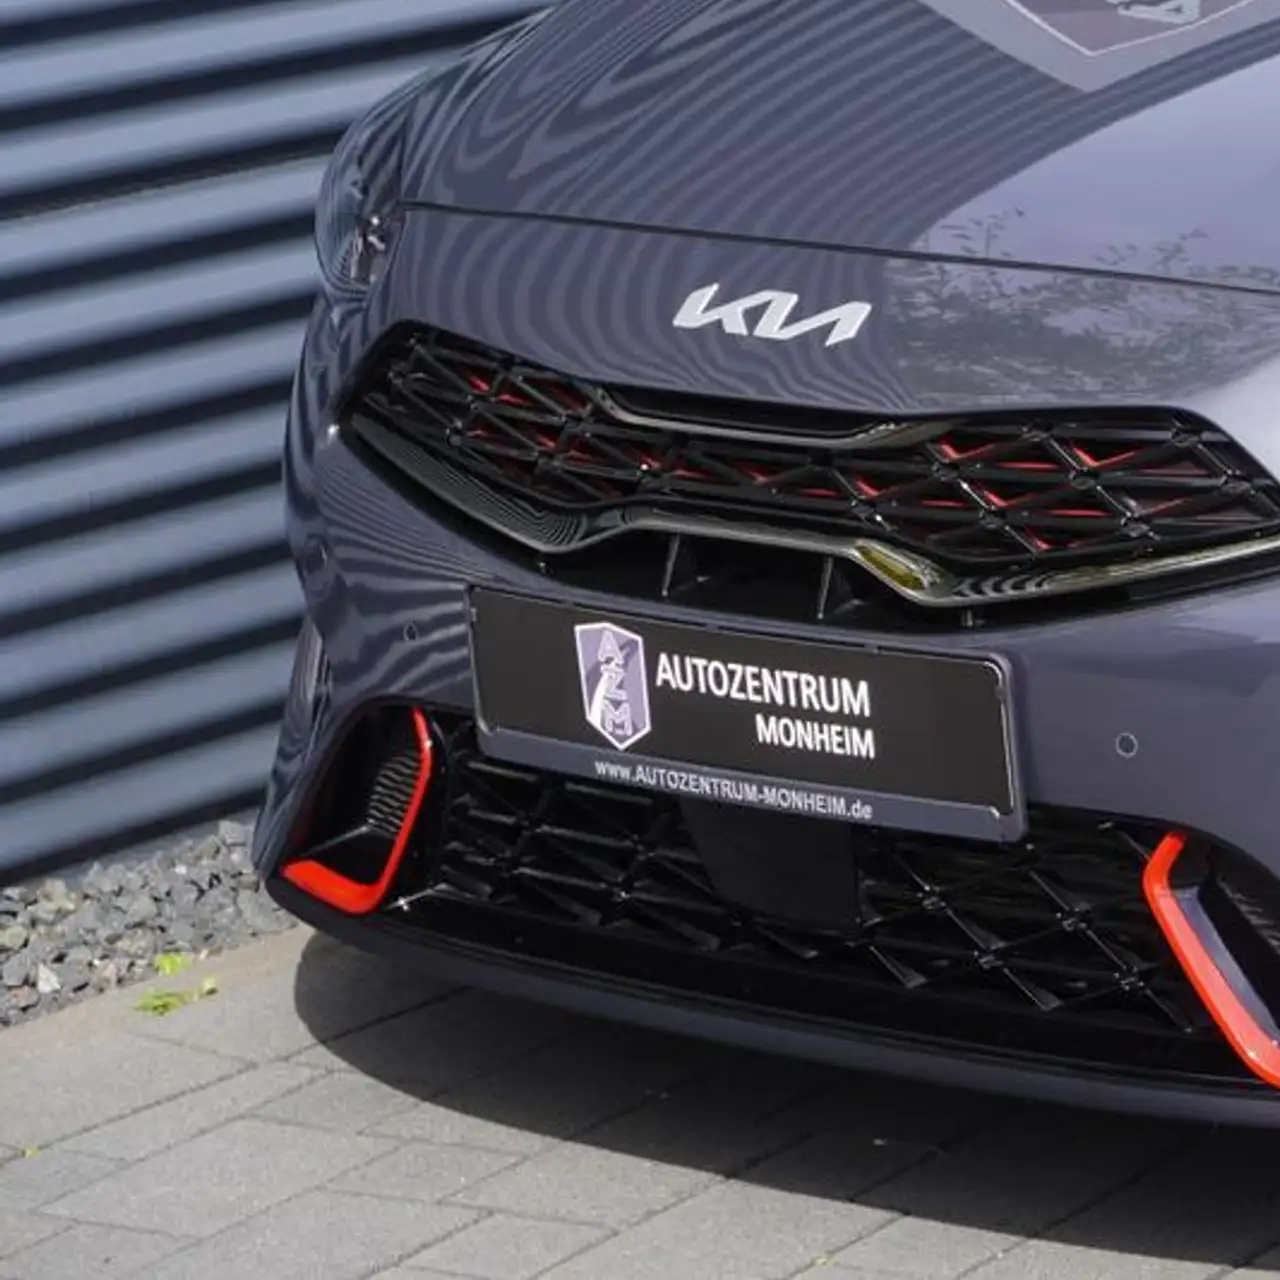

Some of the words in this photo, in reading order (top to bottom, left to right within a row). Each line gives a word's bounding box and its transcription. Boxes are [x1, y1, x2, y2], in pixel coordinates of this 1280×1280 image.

[672, 282, 872, 347] KIA
[655, 651, 872, 718] AUTOZENTRUM
[755, 713, 876, 760] MONHEIM
[594, 760, 874, 820] www.AUTOZENTRUM-MONHEIM.de
